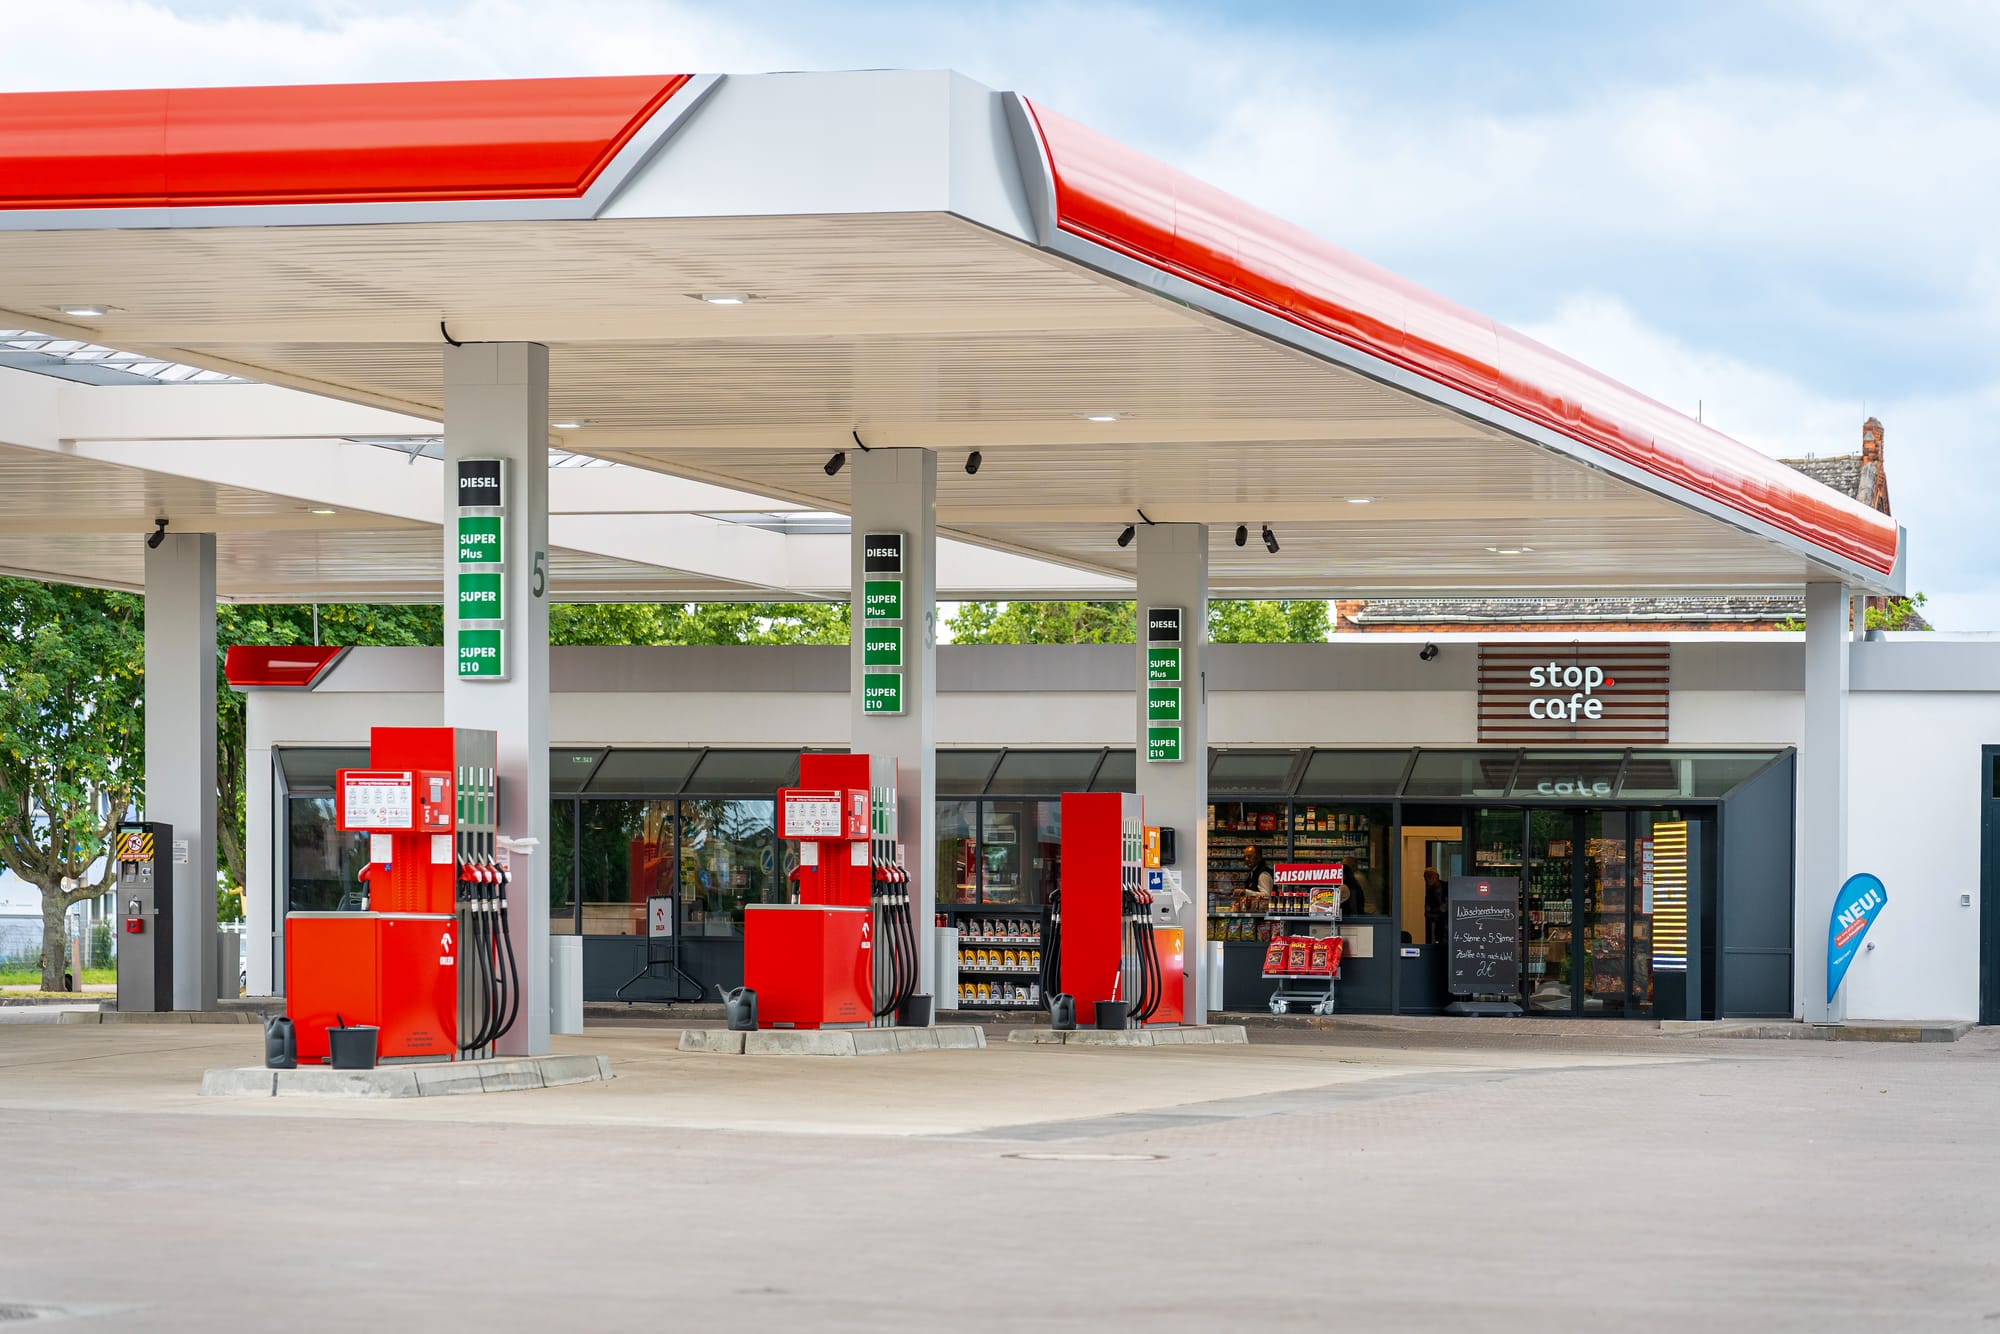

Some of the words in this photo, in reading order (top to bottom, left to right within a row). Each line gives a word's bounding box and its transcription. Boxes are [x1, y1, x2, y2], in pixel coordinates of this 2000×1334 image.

[460, 477, 498, 488] DIESEL
[460, 534, 496, 544] SUPER
[460, 548, 482, 559] Plus
[866, 549, 899, 557] DIESEL
[532, 551, 545, 598] 5
[460, 592, 496, 602] SUPER
[866, 595, 897, 604] SUPER
[867, 607, 886, 616] Plus
[1150, 621, 1178, 629] DIESEL
[925, 611, 933, 649] 3
[866, 642, 897, 651] SUPER
[460, 647, 496, 658] SUPER
[460, 662, 480, 673] E10
[1150, 660, 1176, 668] SUPER
[1150, 670, 1167, 678] Plus
[866, 688, 897, 697] SUPER
[866, 700, 883, 709] E10
[1150, 700, 1176, 708] SUPER
[1529, 693, 1604, 723] cafe
[1150, 739, 1176, 747] SUPER
[1150, 750, 1165, 758] E10
[1274, 868, 1343, 882] SAISONWARE
[1837, 888, 1881, 929] NEU!
